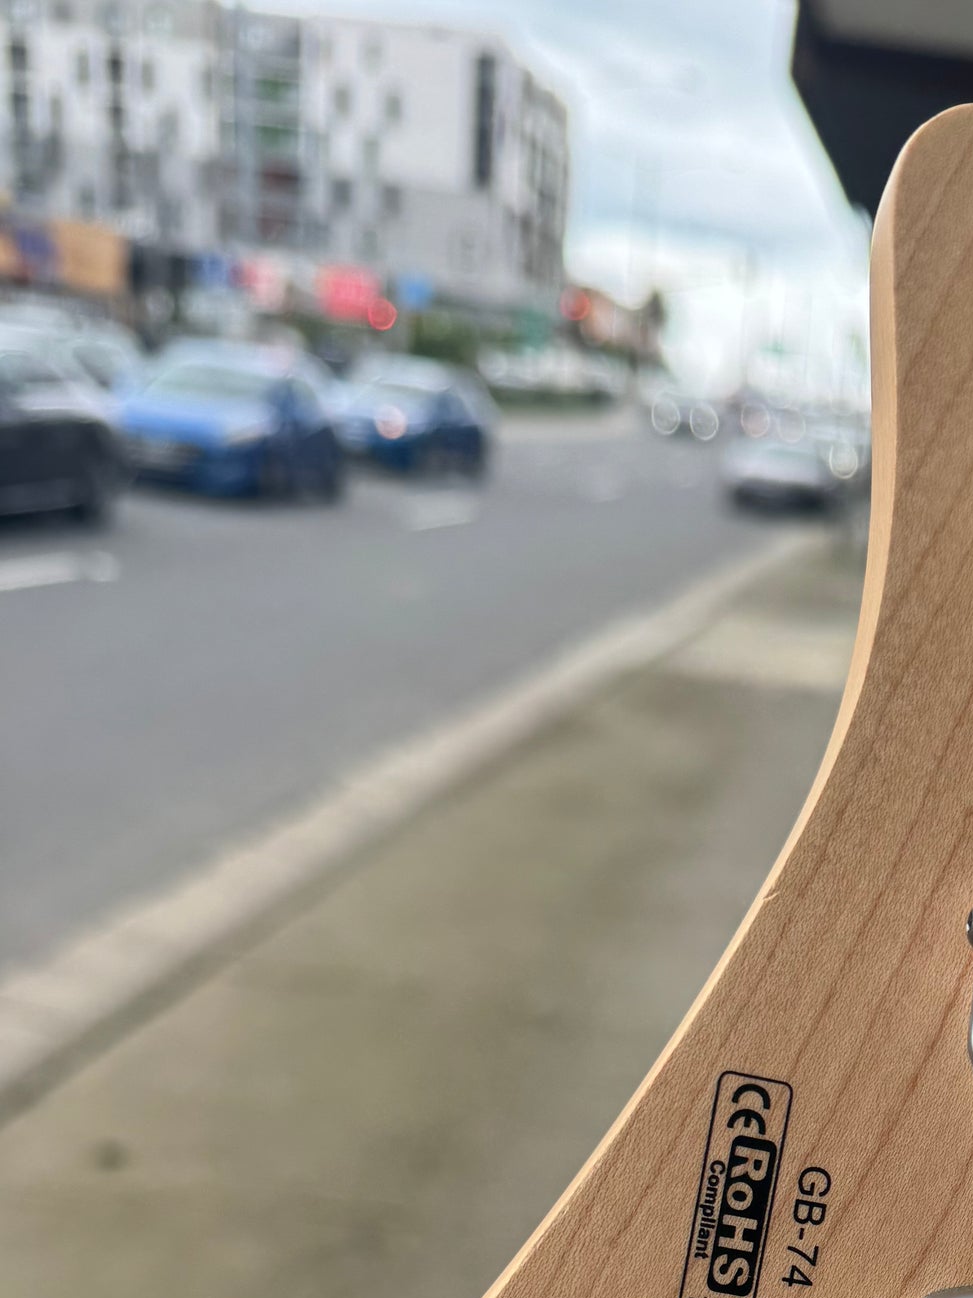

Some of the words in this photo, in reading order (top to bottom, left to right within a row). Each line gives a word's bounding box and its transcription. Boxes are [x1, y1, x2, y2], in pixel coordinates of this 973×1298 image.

[694, 1159, 726, 1260] Compliant
[711, 1145, 771, 1288] RoHS
[781, 1166, 832, 1288] GB-74
